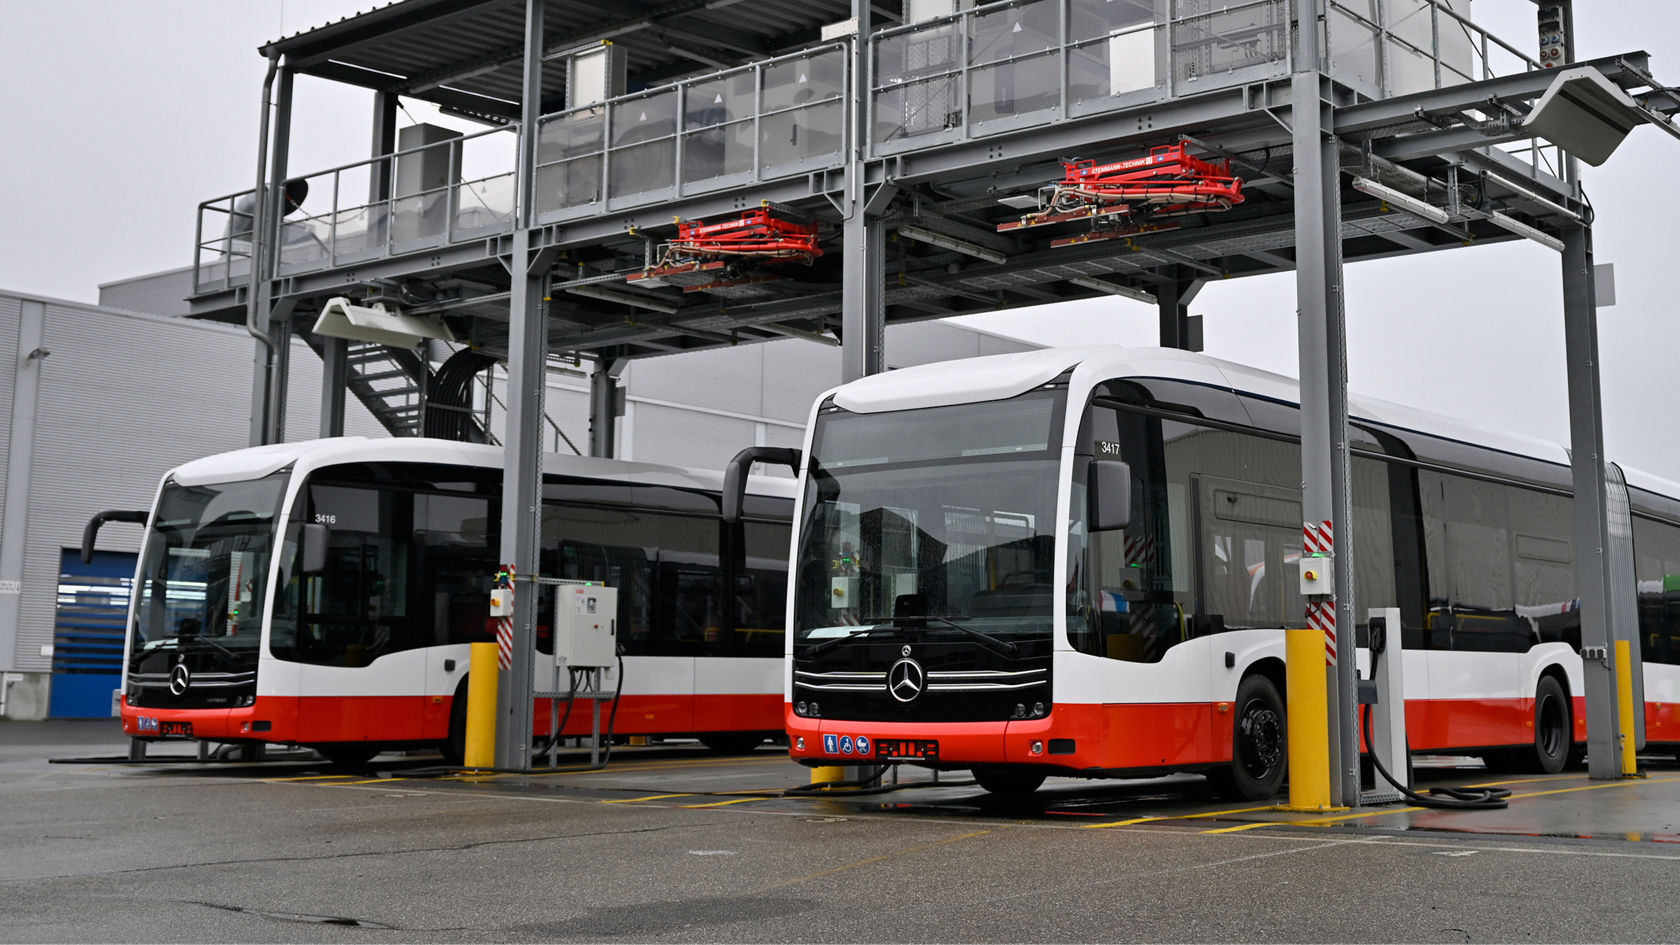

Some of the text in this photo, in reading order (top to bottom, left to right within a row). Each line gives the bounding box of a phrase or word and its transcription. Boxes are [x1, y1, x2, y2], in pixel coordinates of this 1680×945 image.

[1091, 160, 1146, 175] STEMMANN-TECHNIK
[1101, 441, 1120, 455] 3417
[314, 513, 336, 524] 3416
